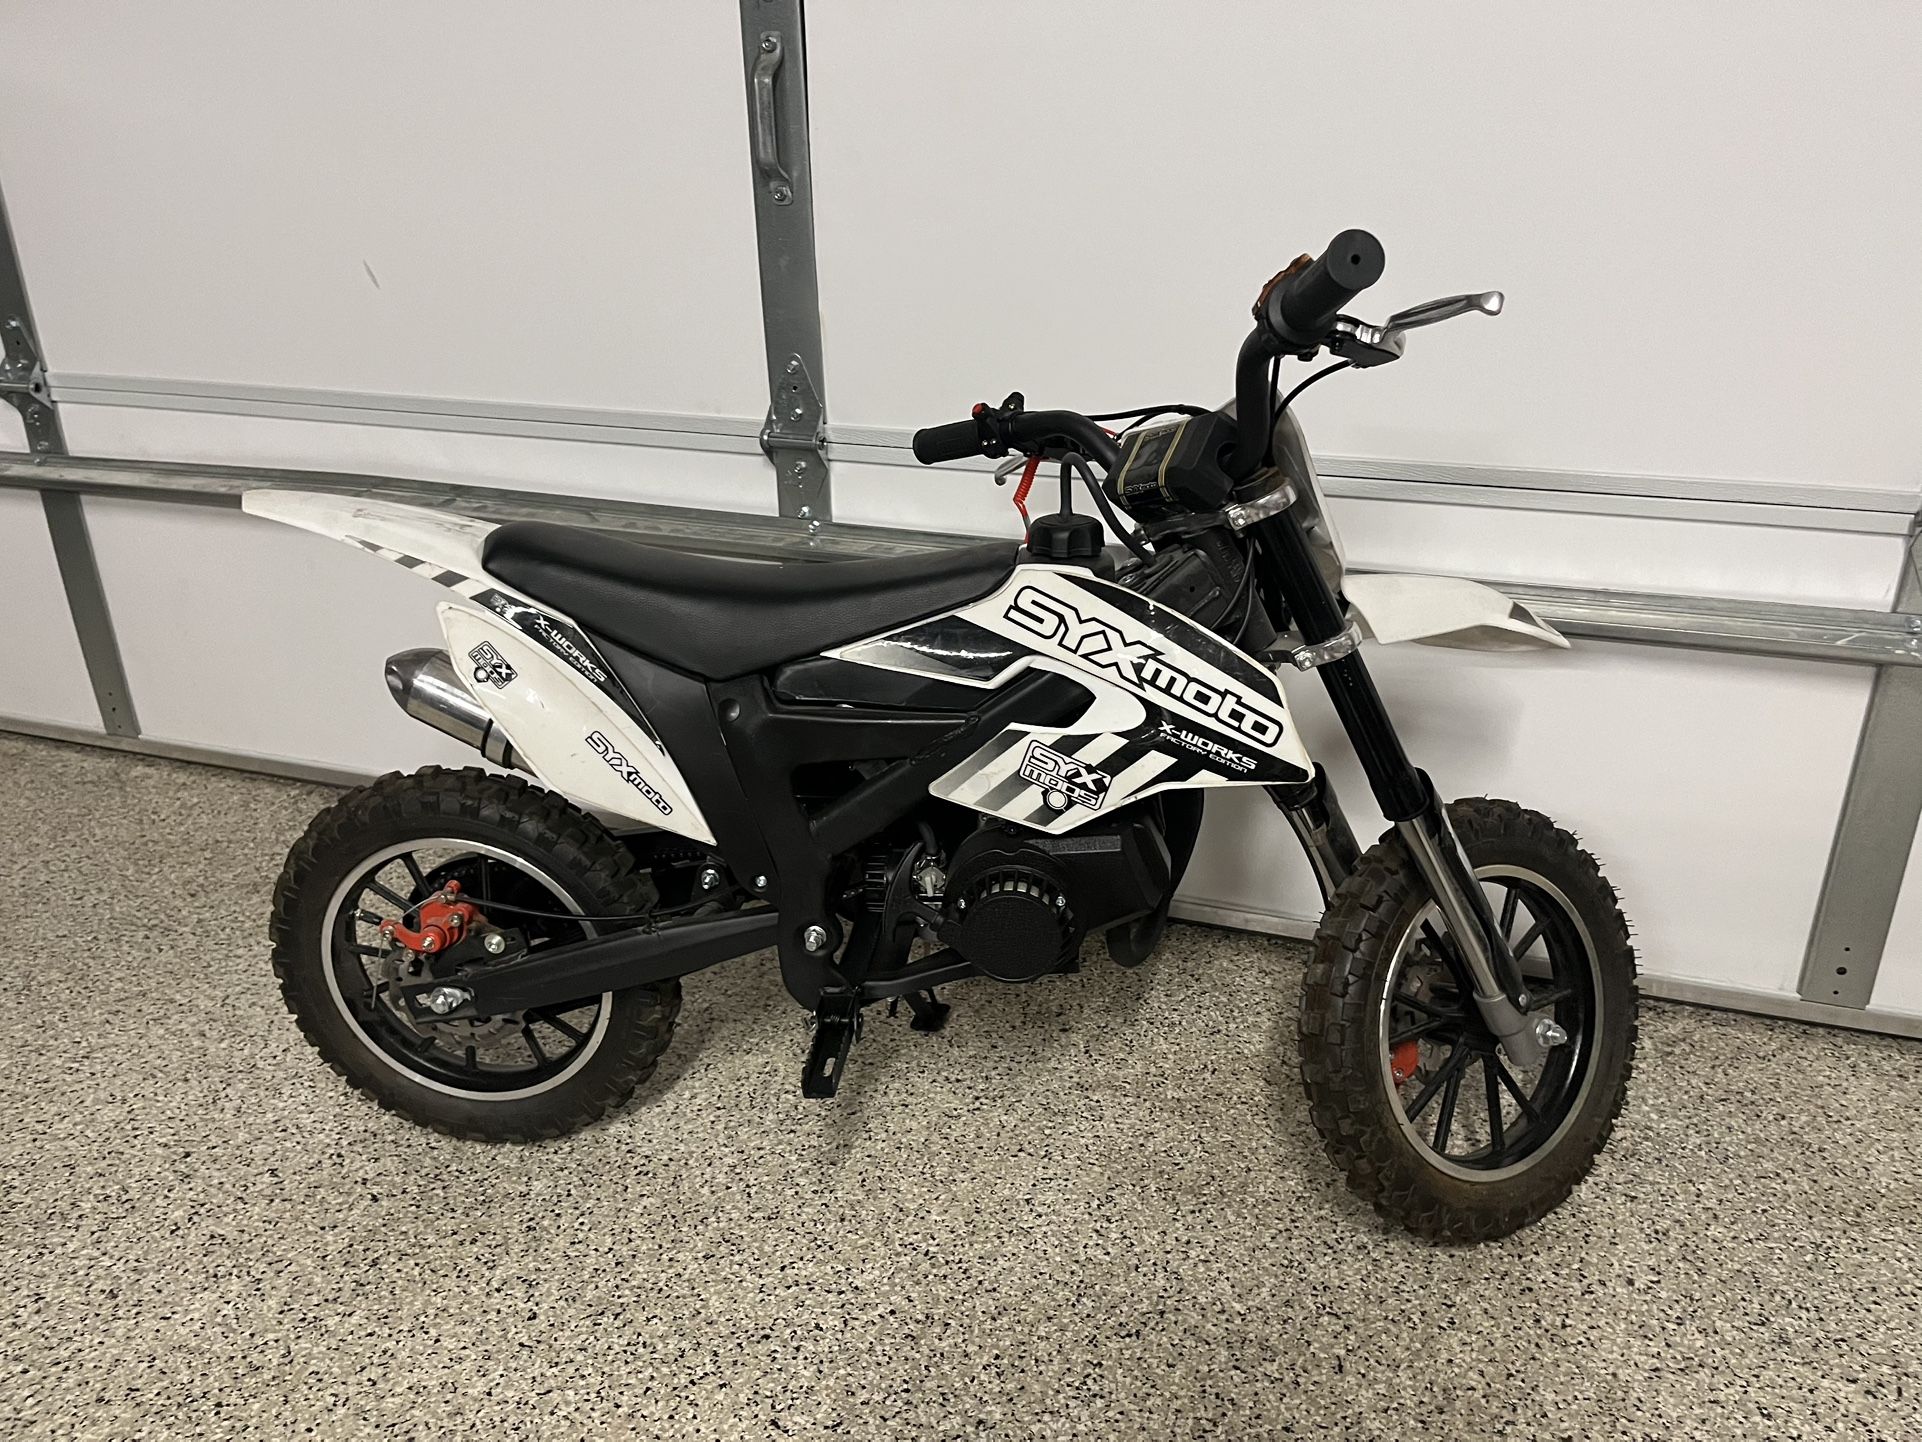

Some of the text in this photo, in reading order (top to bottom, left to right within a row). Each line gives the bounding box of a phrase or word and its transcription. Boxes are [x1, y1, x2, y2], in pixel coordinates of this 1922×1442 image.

[478, 644, 513, 681] SYX
[535, 614, 607, 683] X-WORKS
[568, 656, 598, 683] EDITION
[1003, 585, 1284, 748] SYXmoto
[1158, 720, 1258, 771] X-WORKS
[1159, 731, 1249, 774] FACTORY EDITION
[585, 730, 673, 815] SYXmoto
[1023, 764, 1100, 806] MODS
[1028, 746, 1104, 792] SYX
